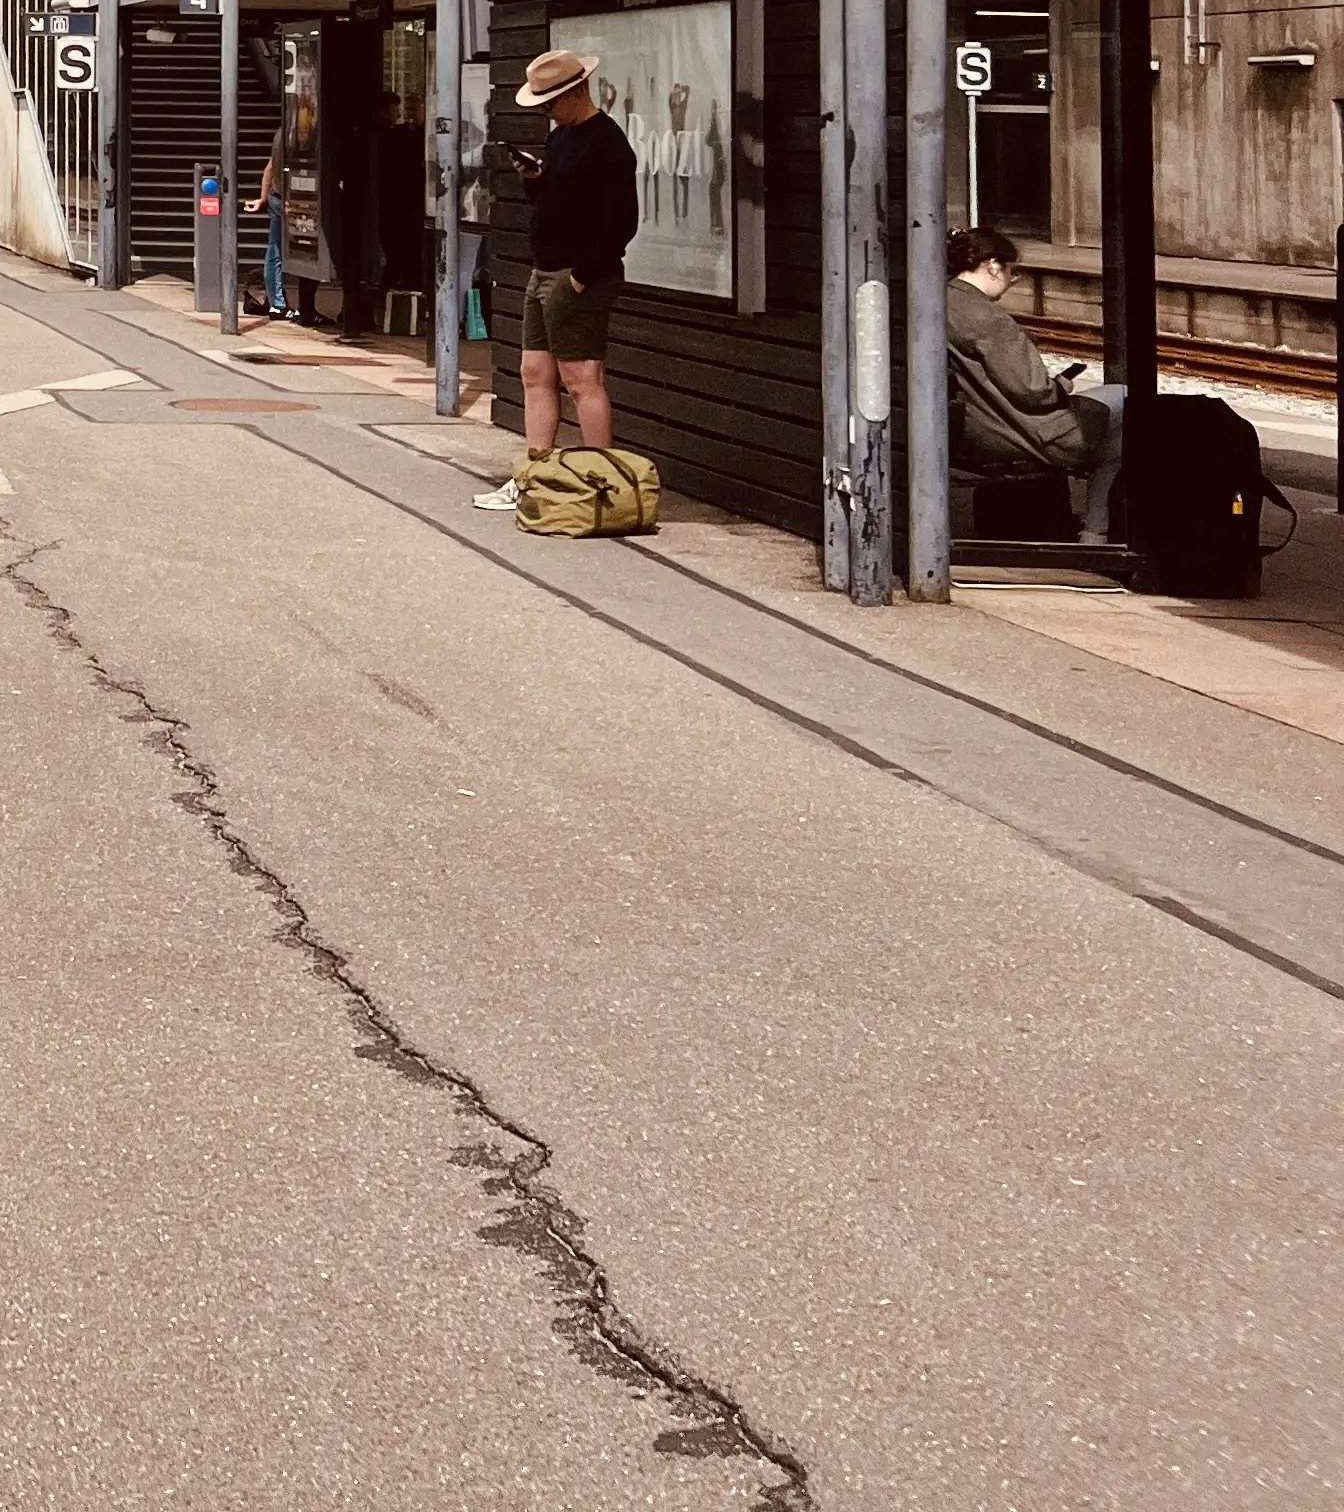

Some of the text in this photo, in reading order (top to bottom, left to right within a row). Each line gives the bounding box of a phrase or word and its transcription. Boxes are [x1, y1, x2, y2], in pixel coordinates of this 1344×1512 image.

[59, 44, 92, 84] S
[960, 52, 989, 86] S
[628, 113, 705, 178] Boozt
